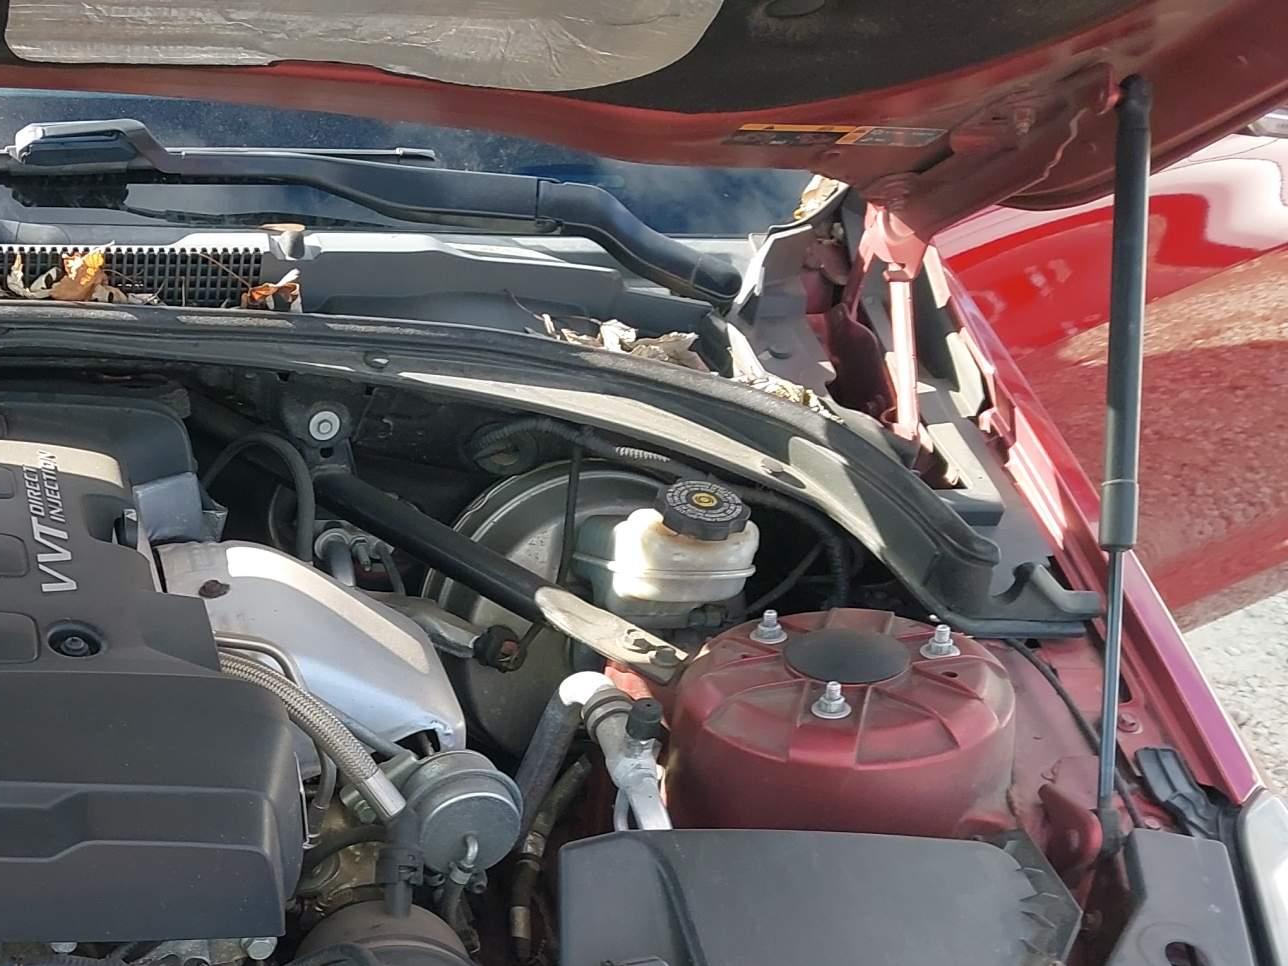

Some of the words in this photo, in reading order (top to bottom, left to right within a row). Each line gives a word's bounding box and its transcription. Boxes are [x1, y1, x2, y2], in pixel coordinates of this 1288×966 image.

[22, 464, 46, 517] DIRECT
[38, 450, 66, 523] INJECTION
[31, 515, 78, 593] VVT
